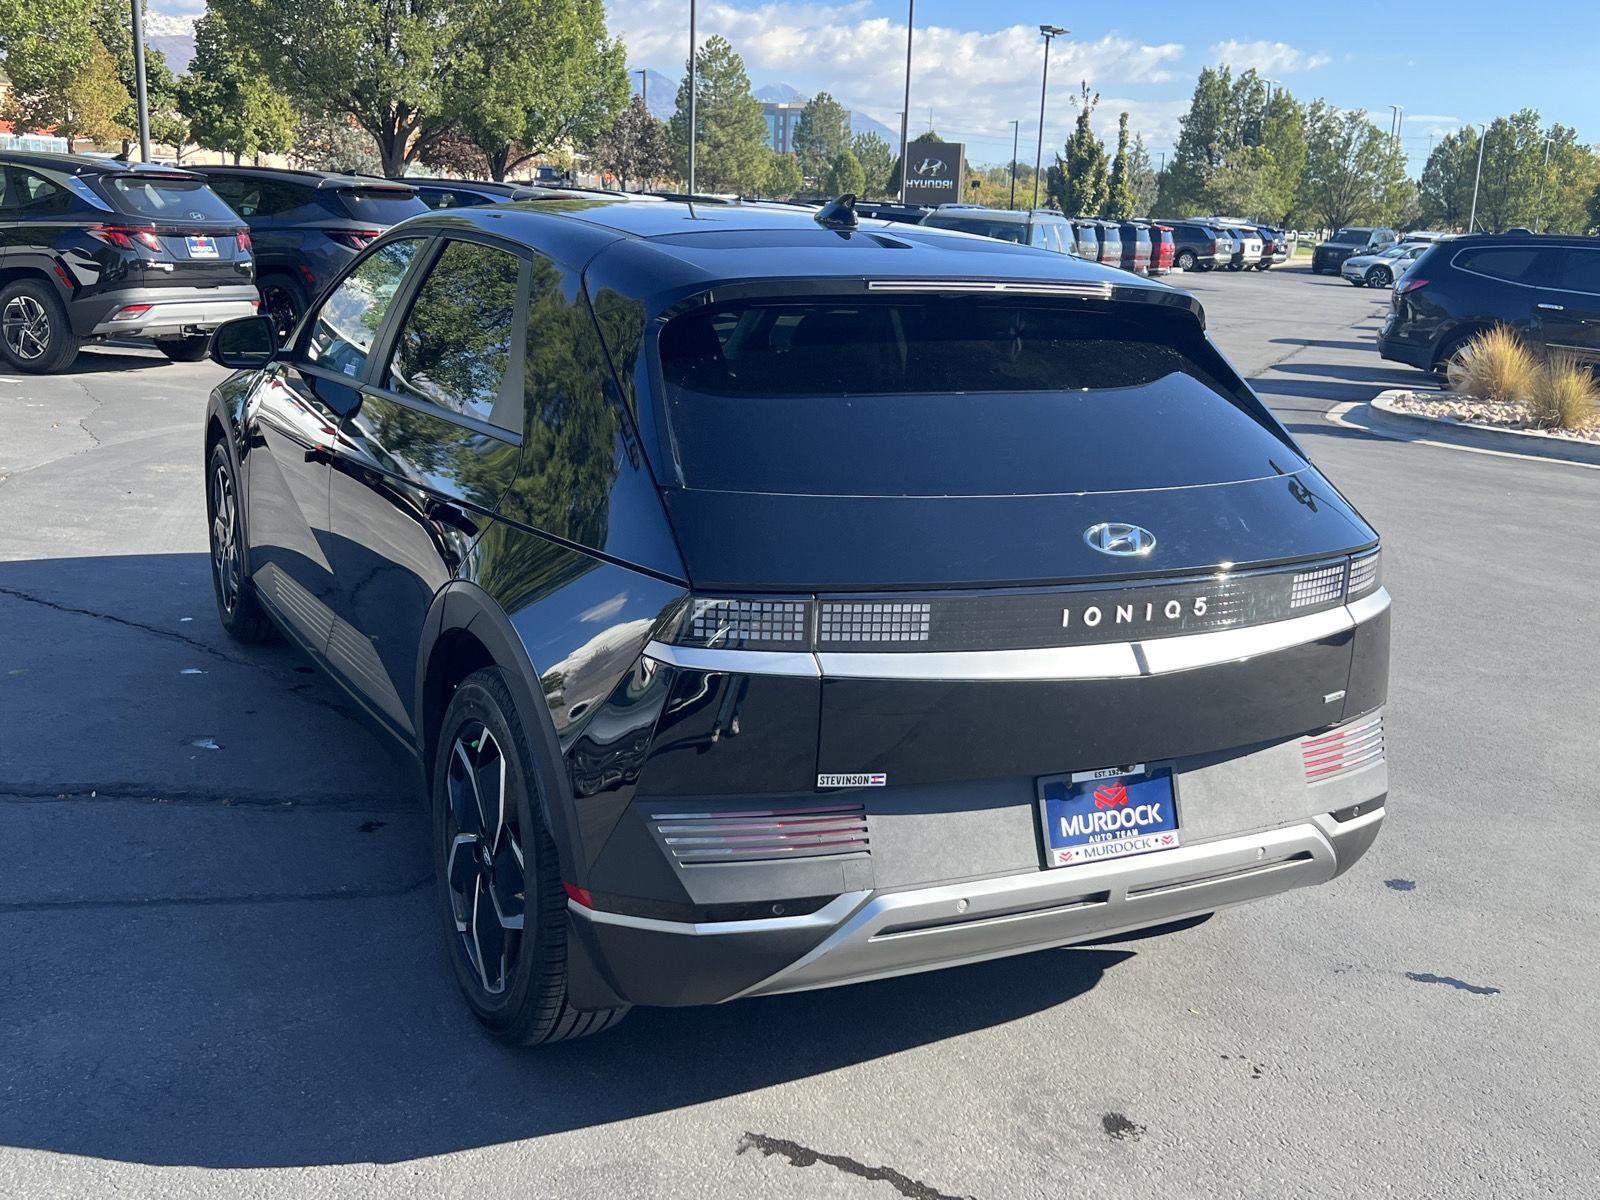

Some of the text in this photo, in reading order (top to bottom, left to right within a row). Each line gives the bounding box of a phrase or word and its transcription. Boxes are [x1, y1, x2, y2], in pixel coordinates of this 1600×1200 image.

[906, 179, 953, 189] HYUNDAI
[819, 775, 870, 785] STEVINSON
[1060, 802, 1163, 837] MURDOCK
[1089, 828, 1138, 843] AUTO TEAM
[1084, 837, 1151, 859] MURDOCK
